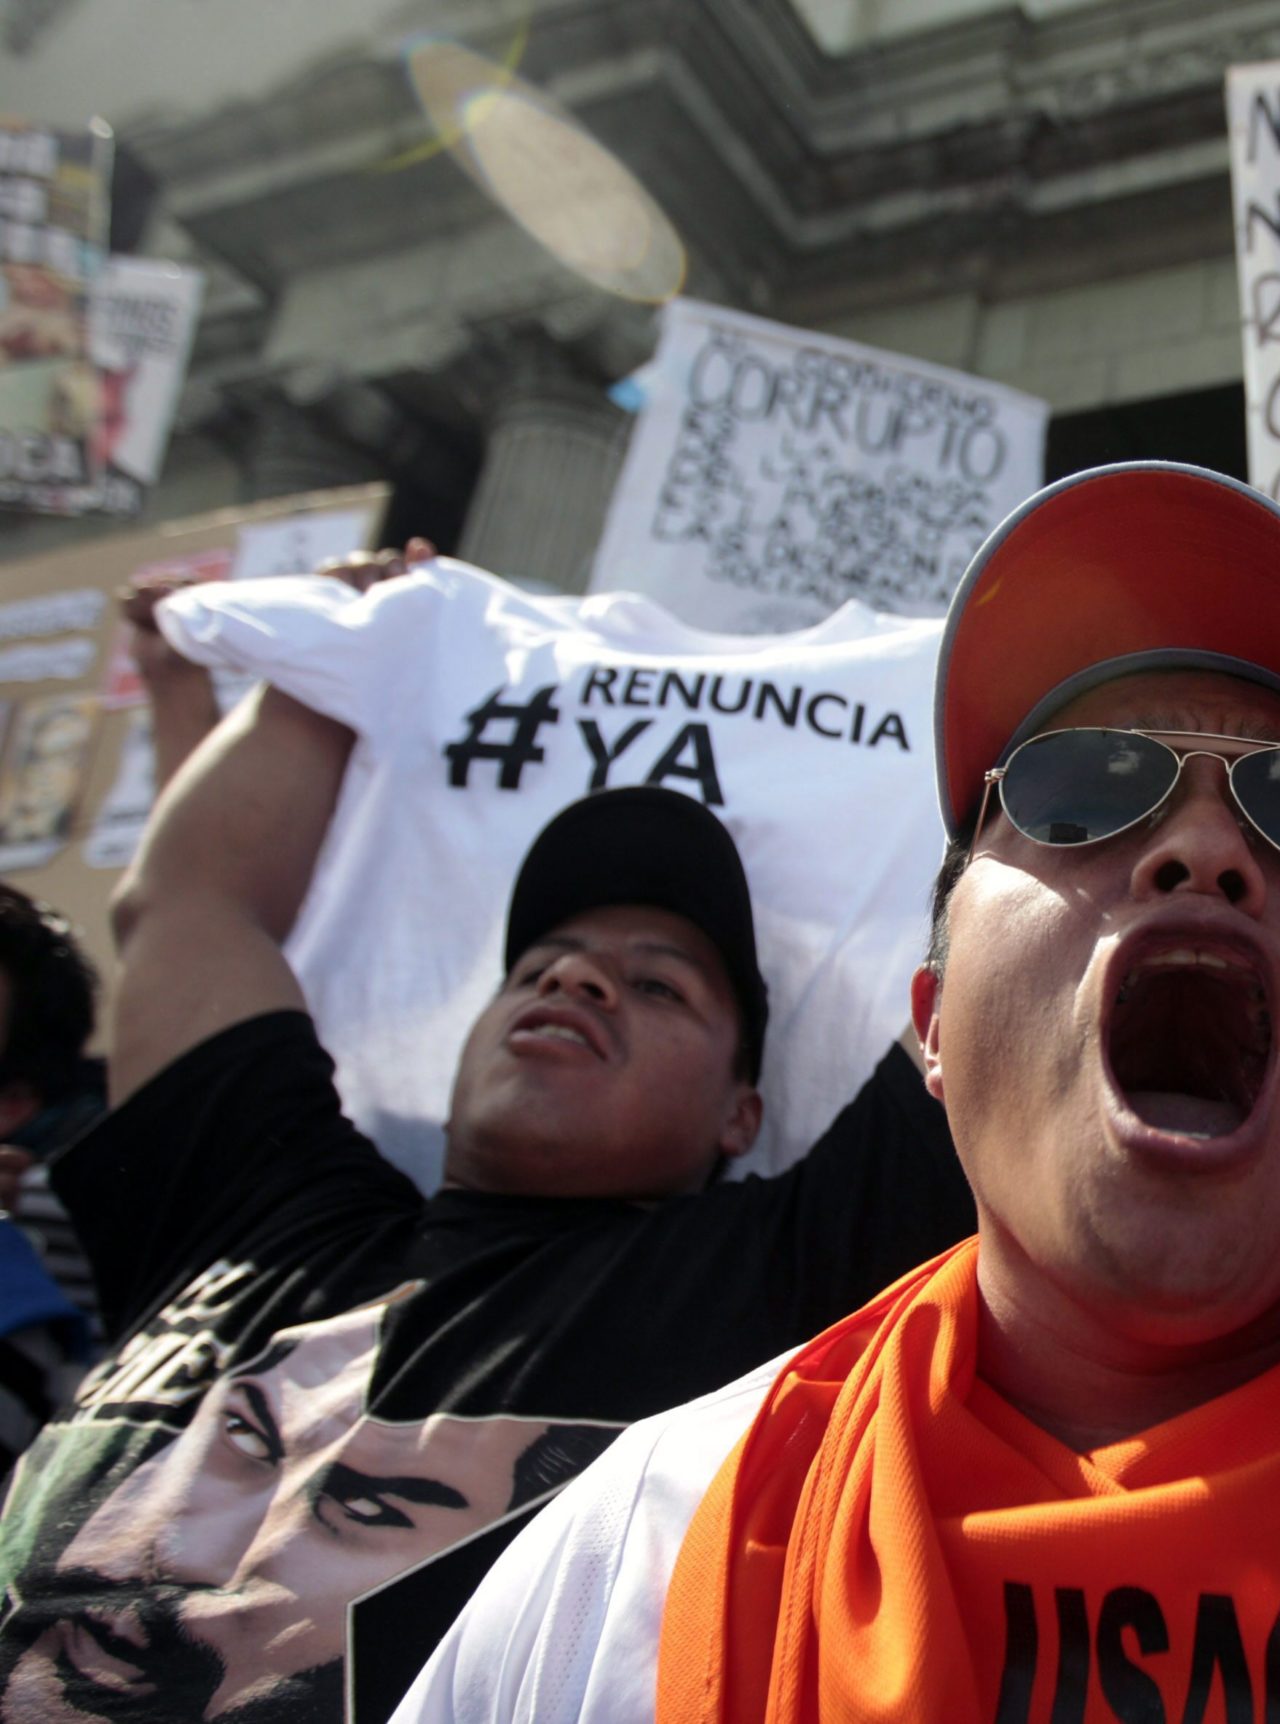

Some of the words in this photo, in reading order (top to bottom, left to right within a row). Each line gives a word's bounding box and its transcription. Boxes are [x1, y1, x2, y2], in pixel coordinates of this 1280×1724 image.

[688, 345, 1006, 486] CORRUPTO
[578, 665, 914, 752] RENUNCIA
[575, 716, 726, 807] YA
